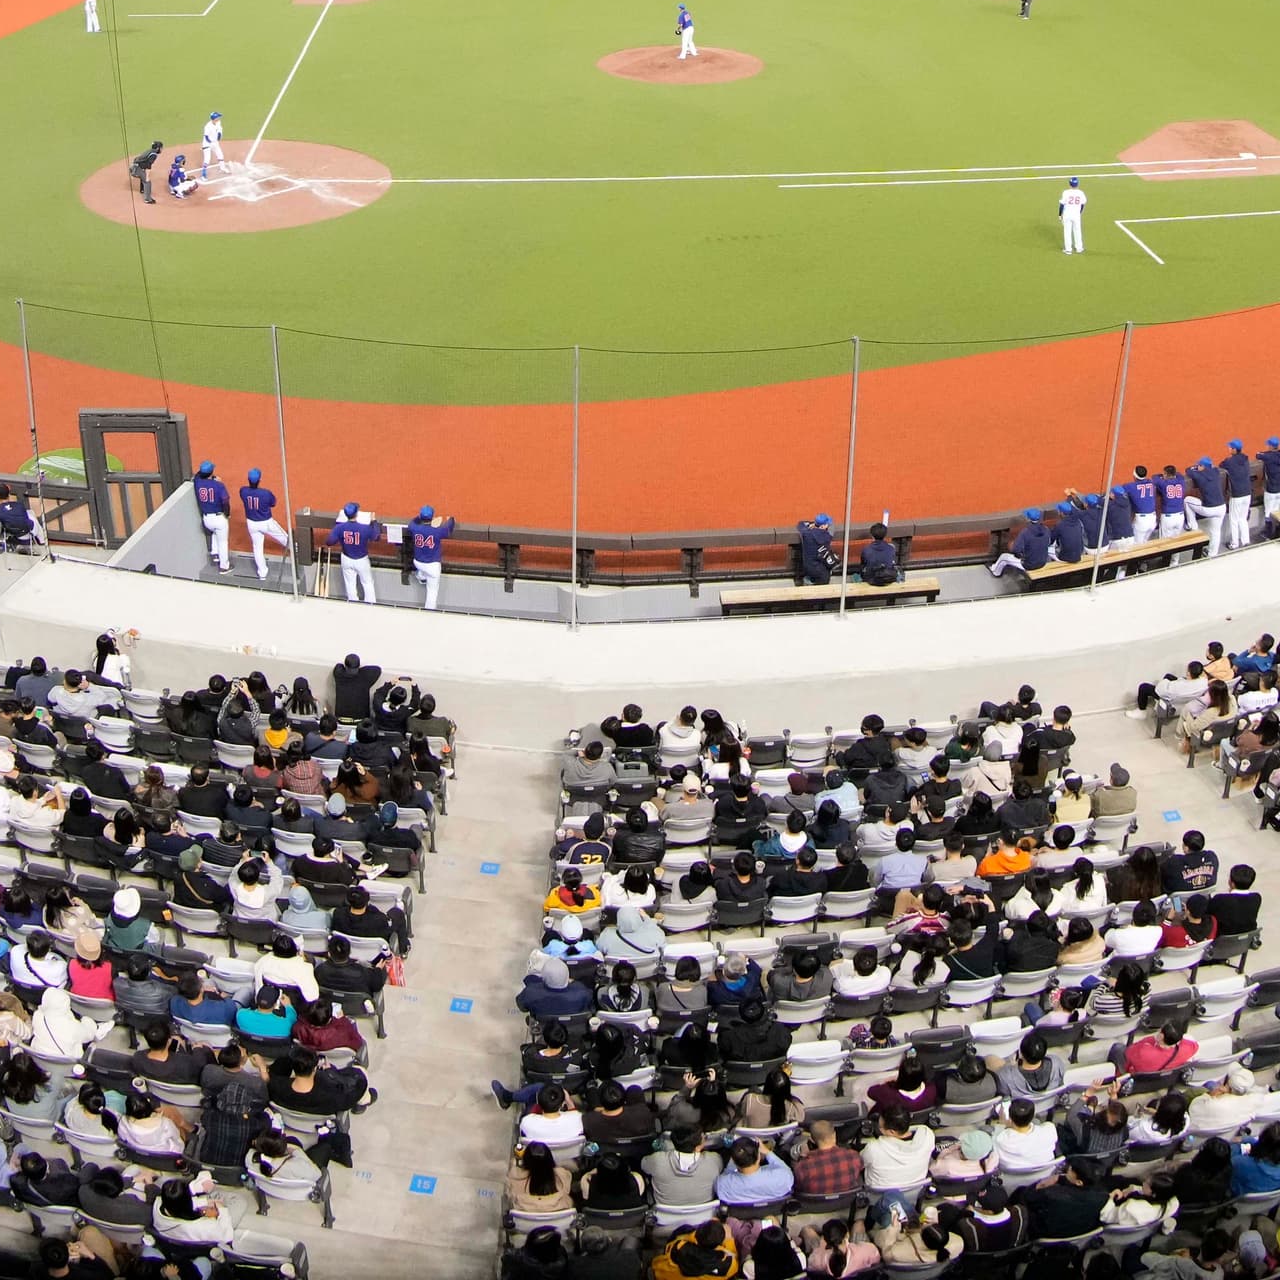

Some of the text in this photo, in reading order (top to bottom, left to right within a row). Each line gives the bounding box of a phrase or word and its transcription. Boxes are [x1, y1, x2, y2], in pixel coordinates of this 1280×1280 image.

[1068, 196, 1080, 205] 26
[199, 488, 214, 502] 81
[1136, 483, 1153, 498] 77
[247, 496, 258, 510] 11
[344, 531, 360, 545] 51
[415, 534, 435, 548] 84
[580, 854, 602, 864] 32
[416, 1178, 430, 1190] 15
